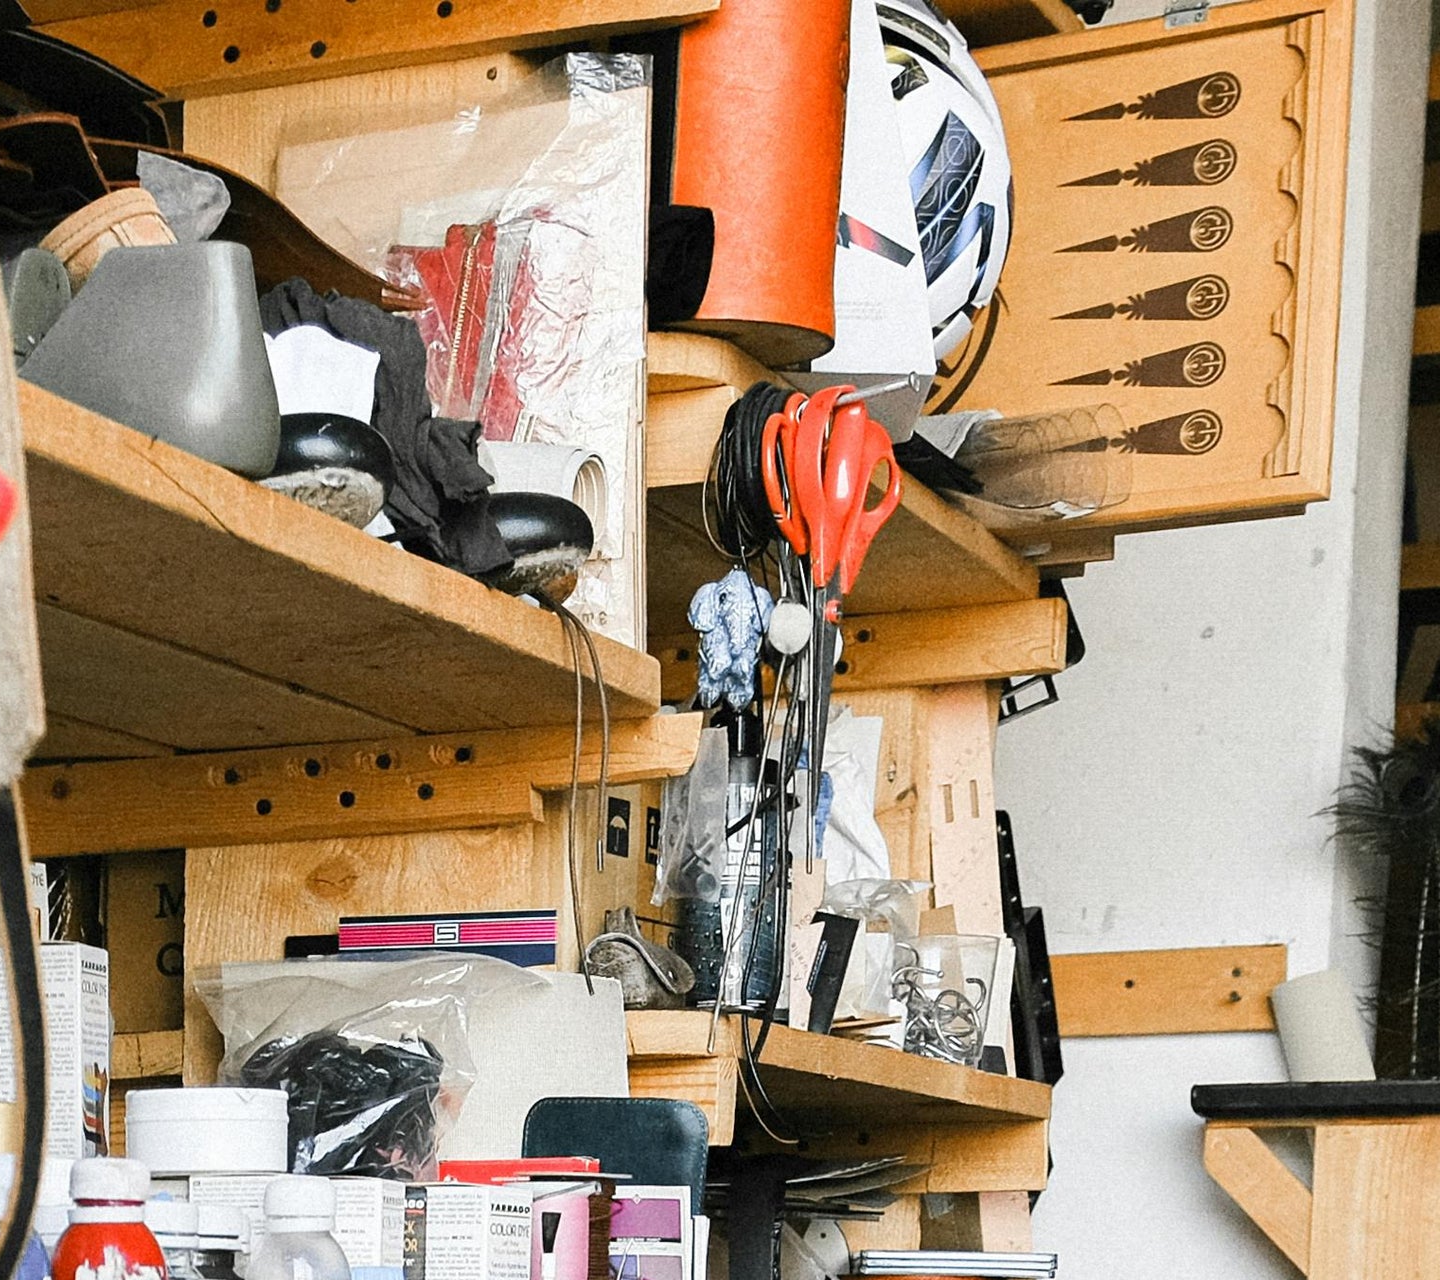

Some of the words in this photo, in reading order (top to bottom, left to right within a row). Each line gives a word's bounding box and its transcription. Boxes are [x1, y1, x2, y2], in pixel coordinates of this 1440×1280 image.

[490, 1204, 530, 1213] TARRAGO
[490, 1223, 516, 1236] COLOR
[517, 1225, 530, 1238] DYE
